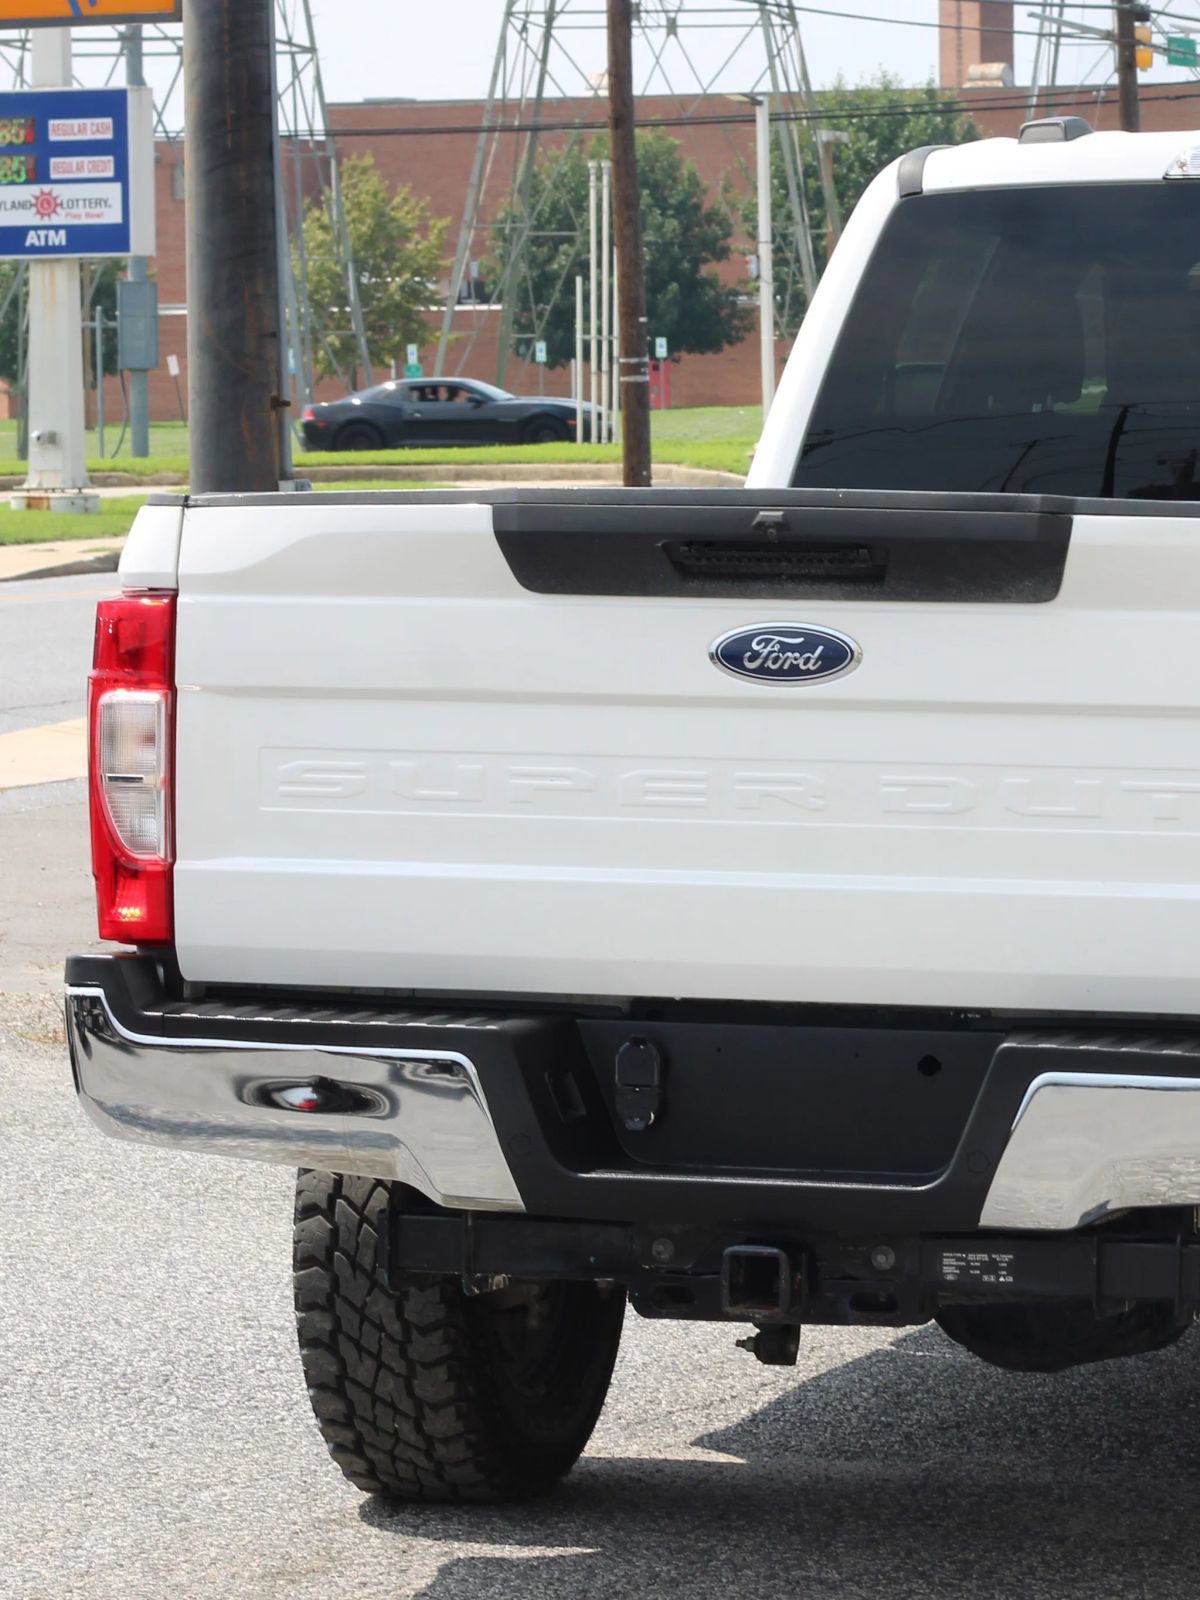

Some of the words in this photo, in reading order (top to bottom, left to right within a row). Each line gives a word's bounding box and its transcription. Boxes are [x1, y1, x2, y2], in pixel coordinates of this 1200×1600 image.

[50, 121, 88, 136] REGULAR
[90, 120, 112, 134] CASH
[52, 160, 86, 174] REGULAR
[87, 159, 112, 173] CREDIT
[60, 198, 109, 209] LOTTERY
[24, 229, 67, 247] ATM
[743, 634, 825, 670] Ford
[277, 760, 826, 812] SUPER
